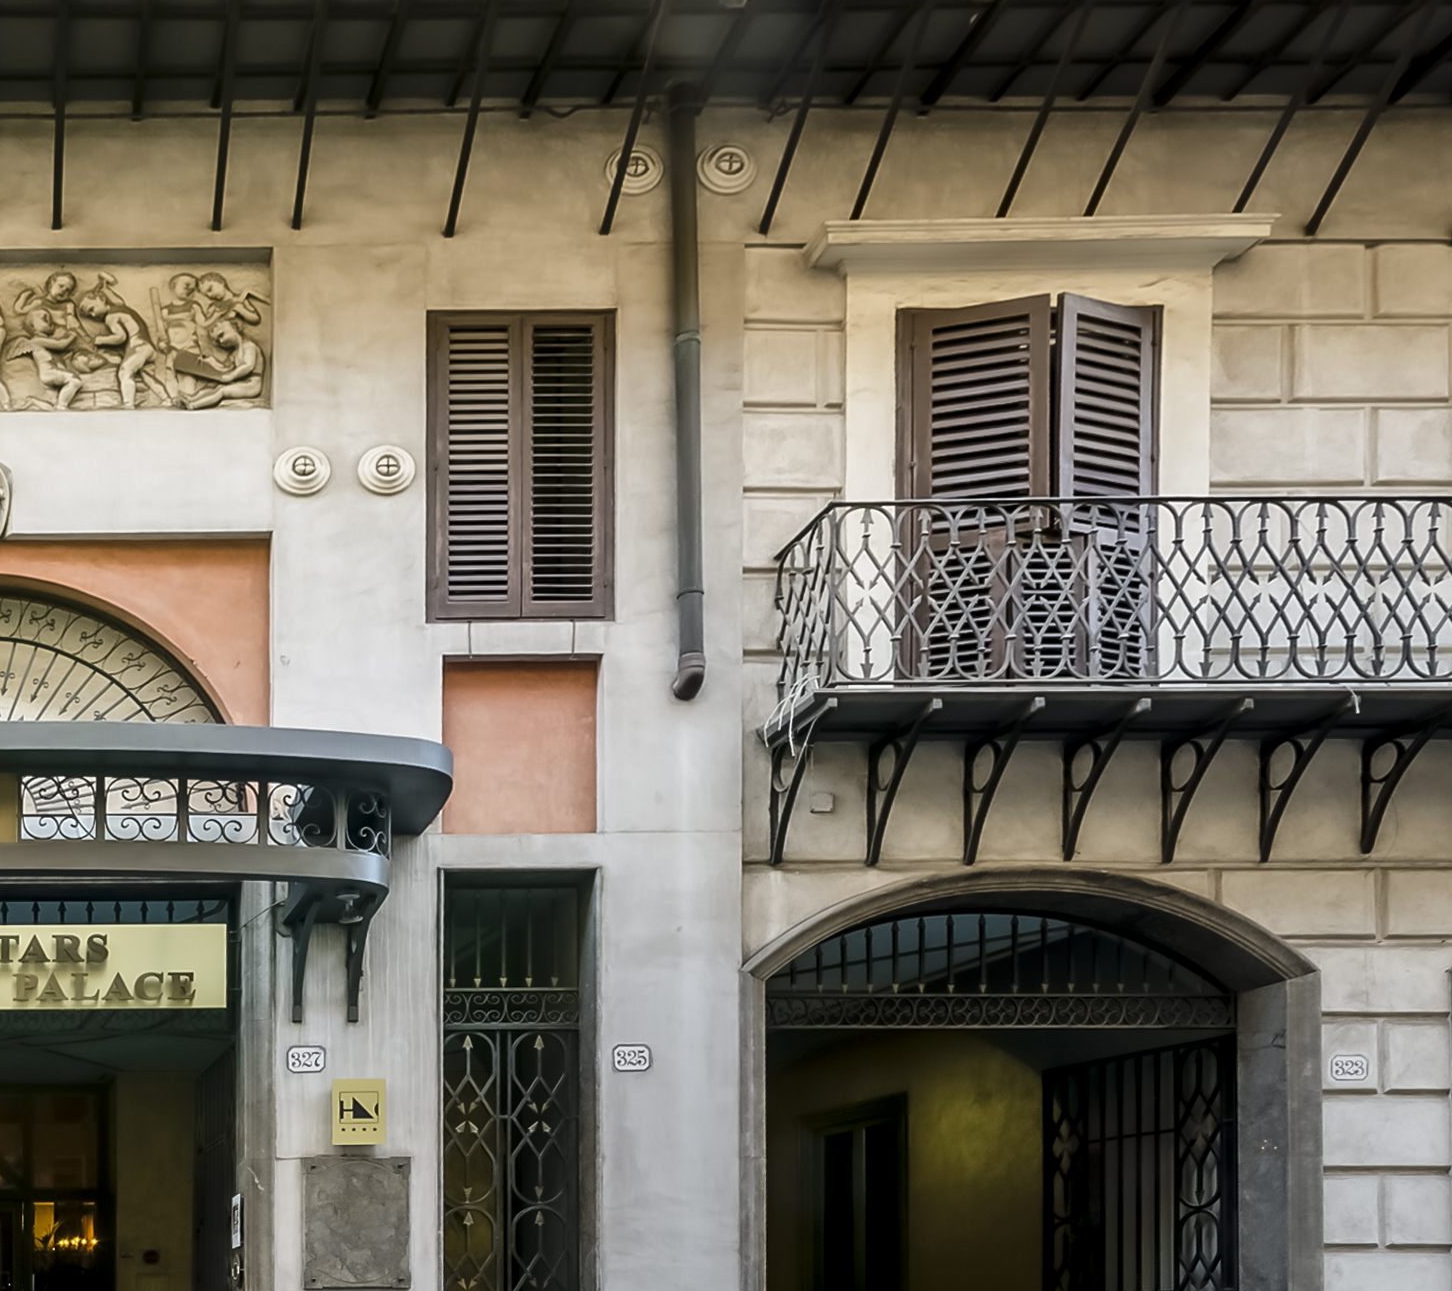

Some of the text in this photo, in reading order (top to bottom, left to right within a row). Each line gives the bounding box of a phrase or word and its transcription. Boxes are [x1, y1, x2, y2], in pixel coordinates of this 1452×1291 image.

[12, 971, 197, 1003] PALACE
[291, 1051, 322, 1068] 327
[616, 1050, 647, 1066] 325
[1335, 1060, 1365, 1076] 323
